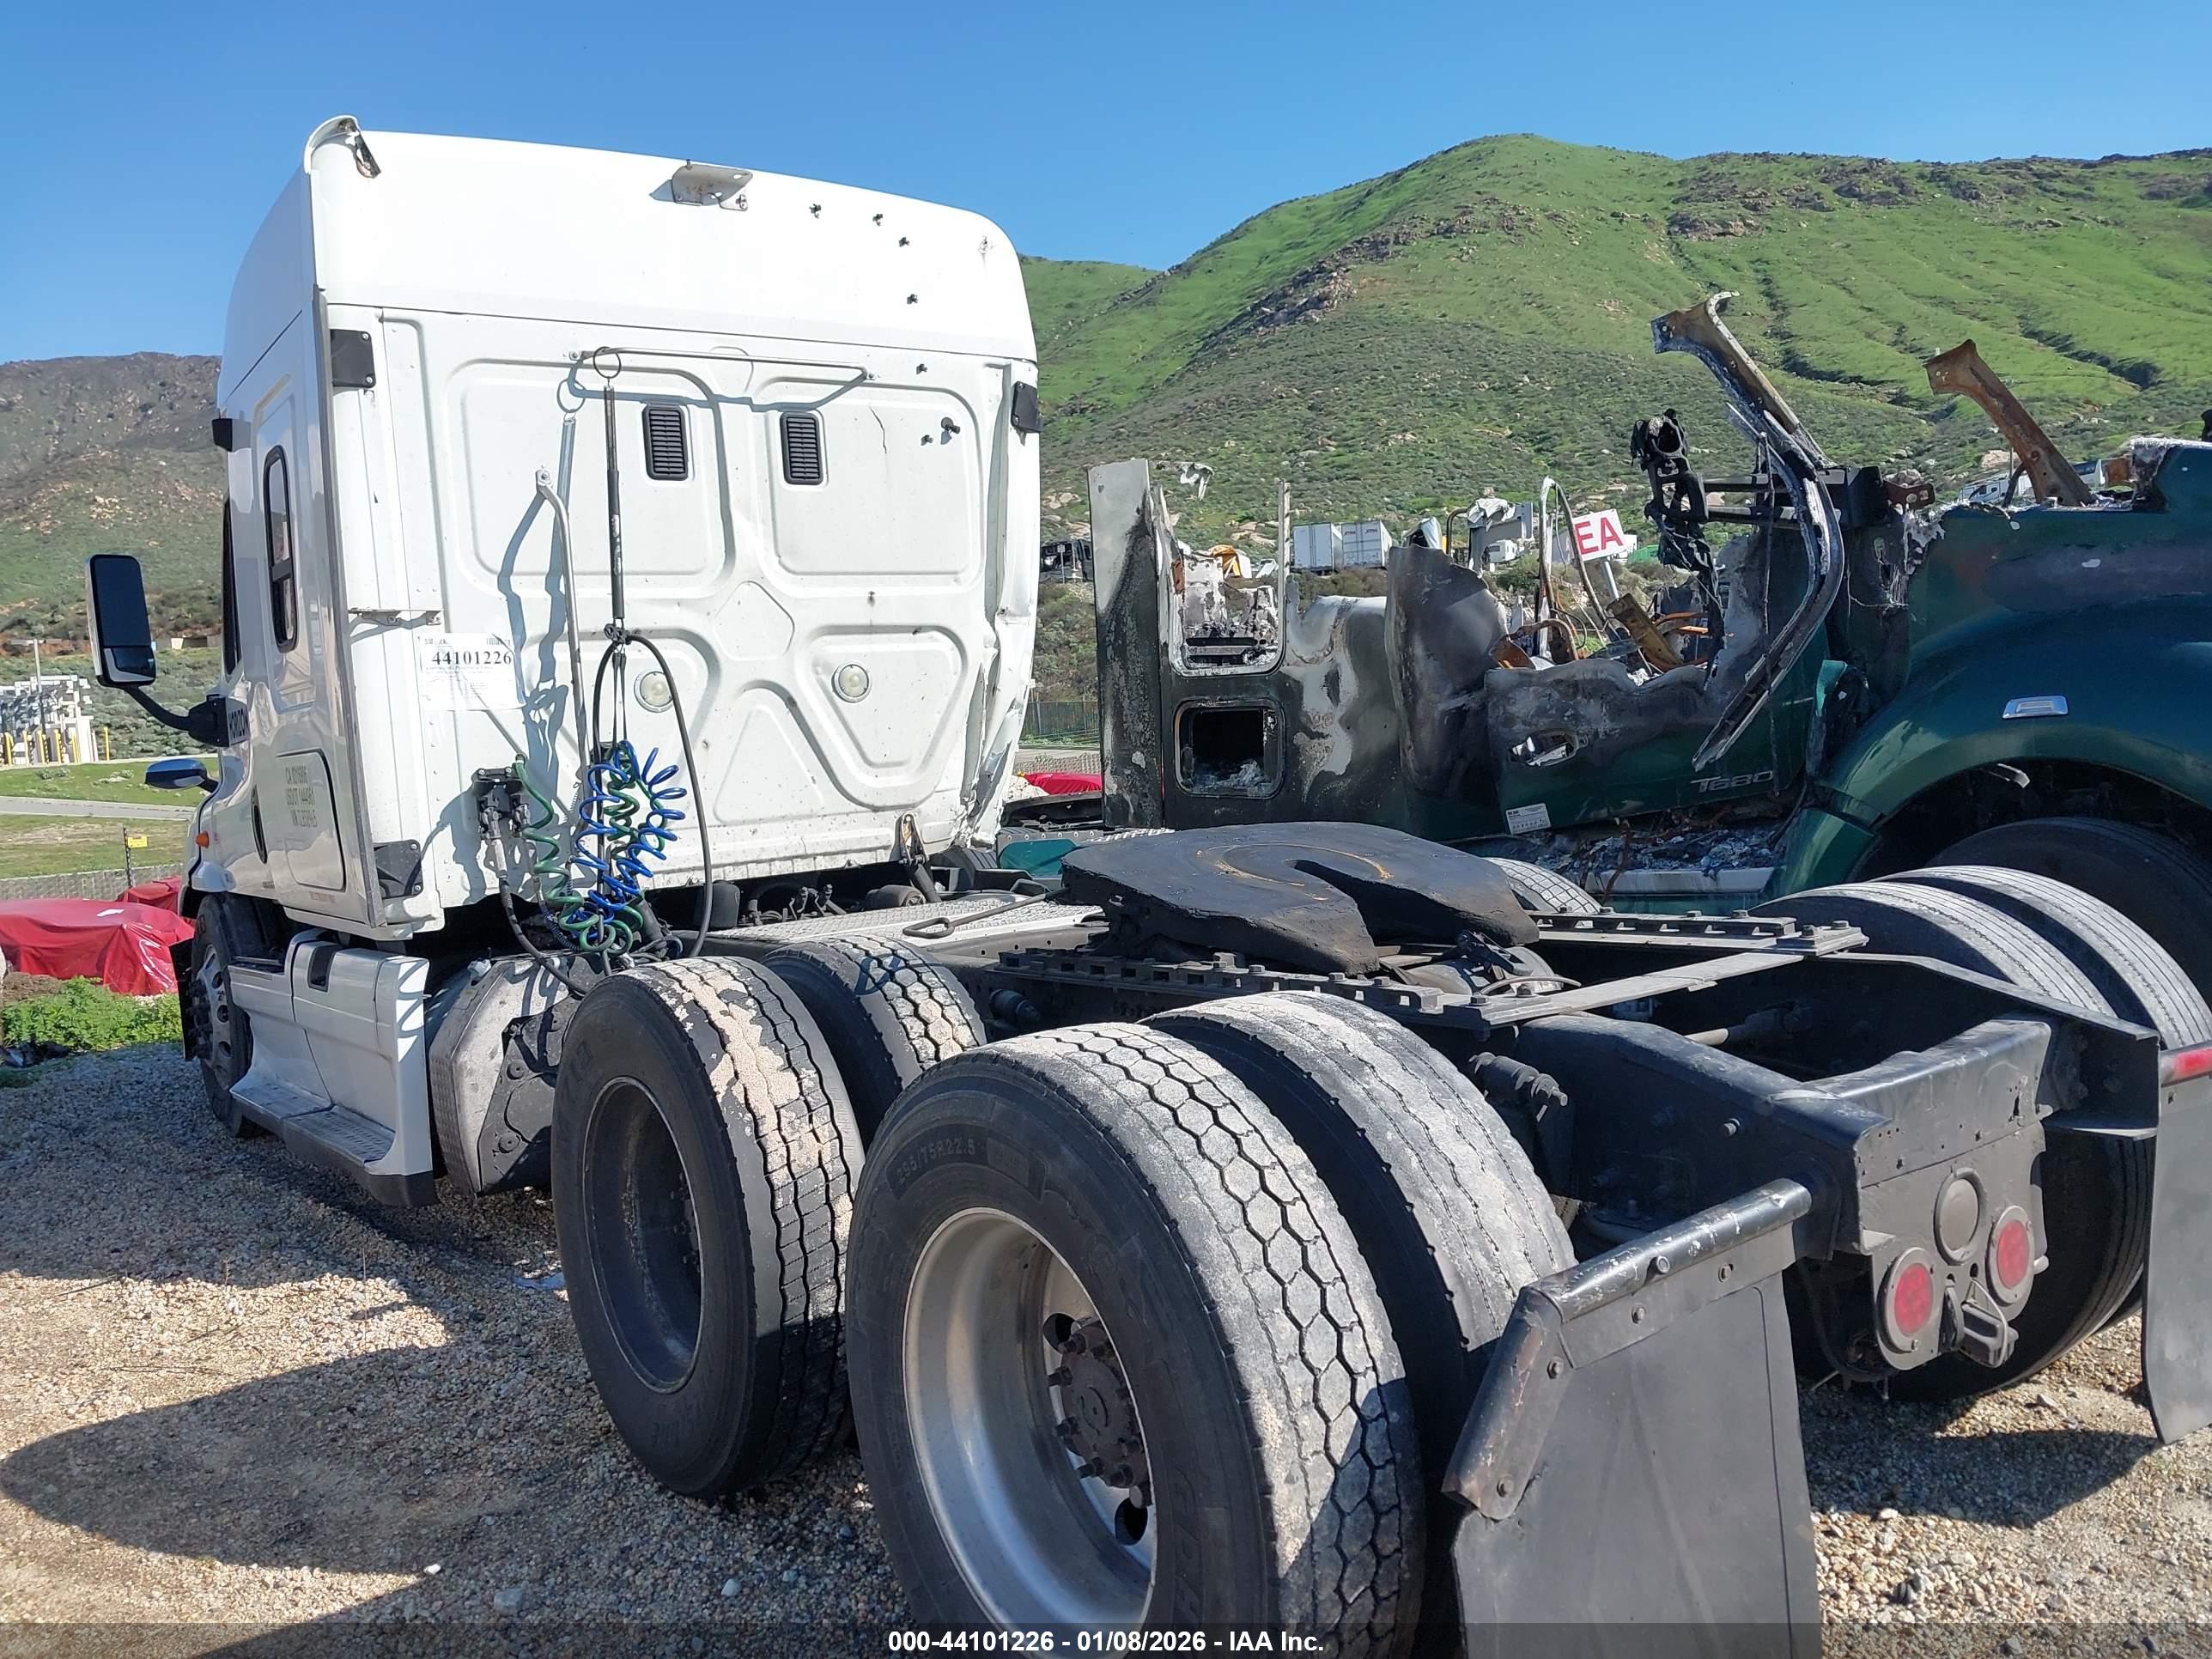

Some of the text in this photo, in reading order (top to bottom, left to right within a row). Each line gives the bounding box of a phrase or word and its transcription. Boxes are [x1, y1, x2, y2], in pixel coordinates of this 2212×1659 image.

[1574, 517, 1624, 555] EA
[432, 651, 512, 665] 44101226
[1690, 770, 1773, 793] T680
